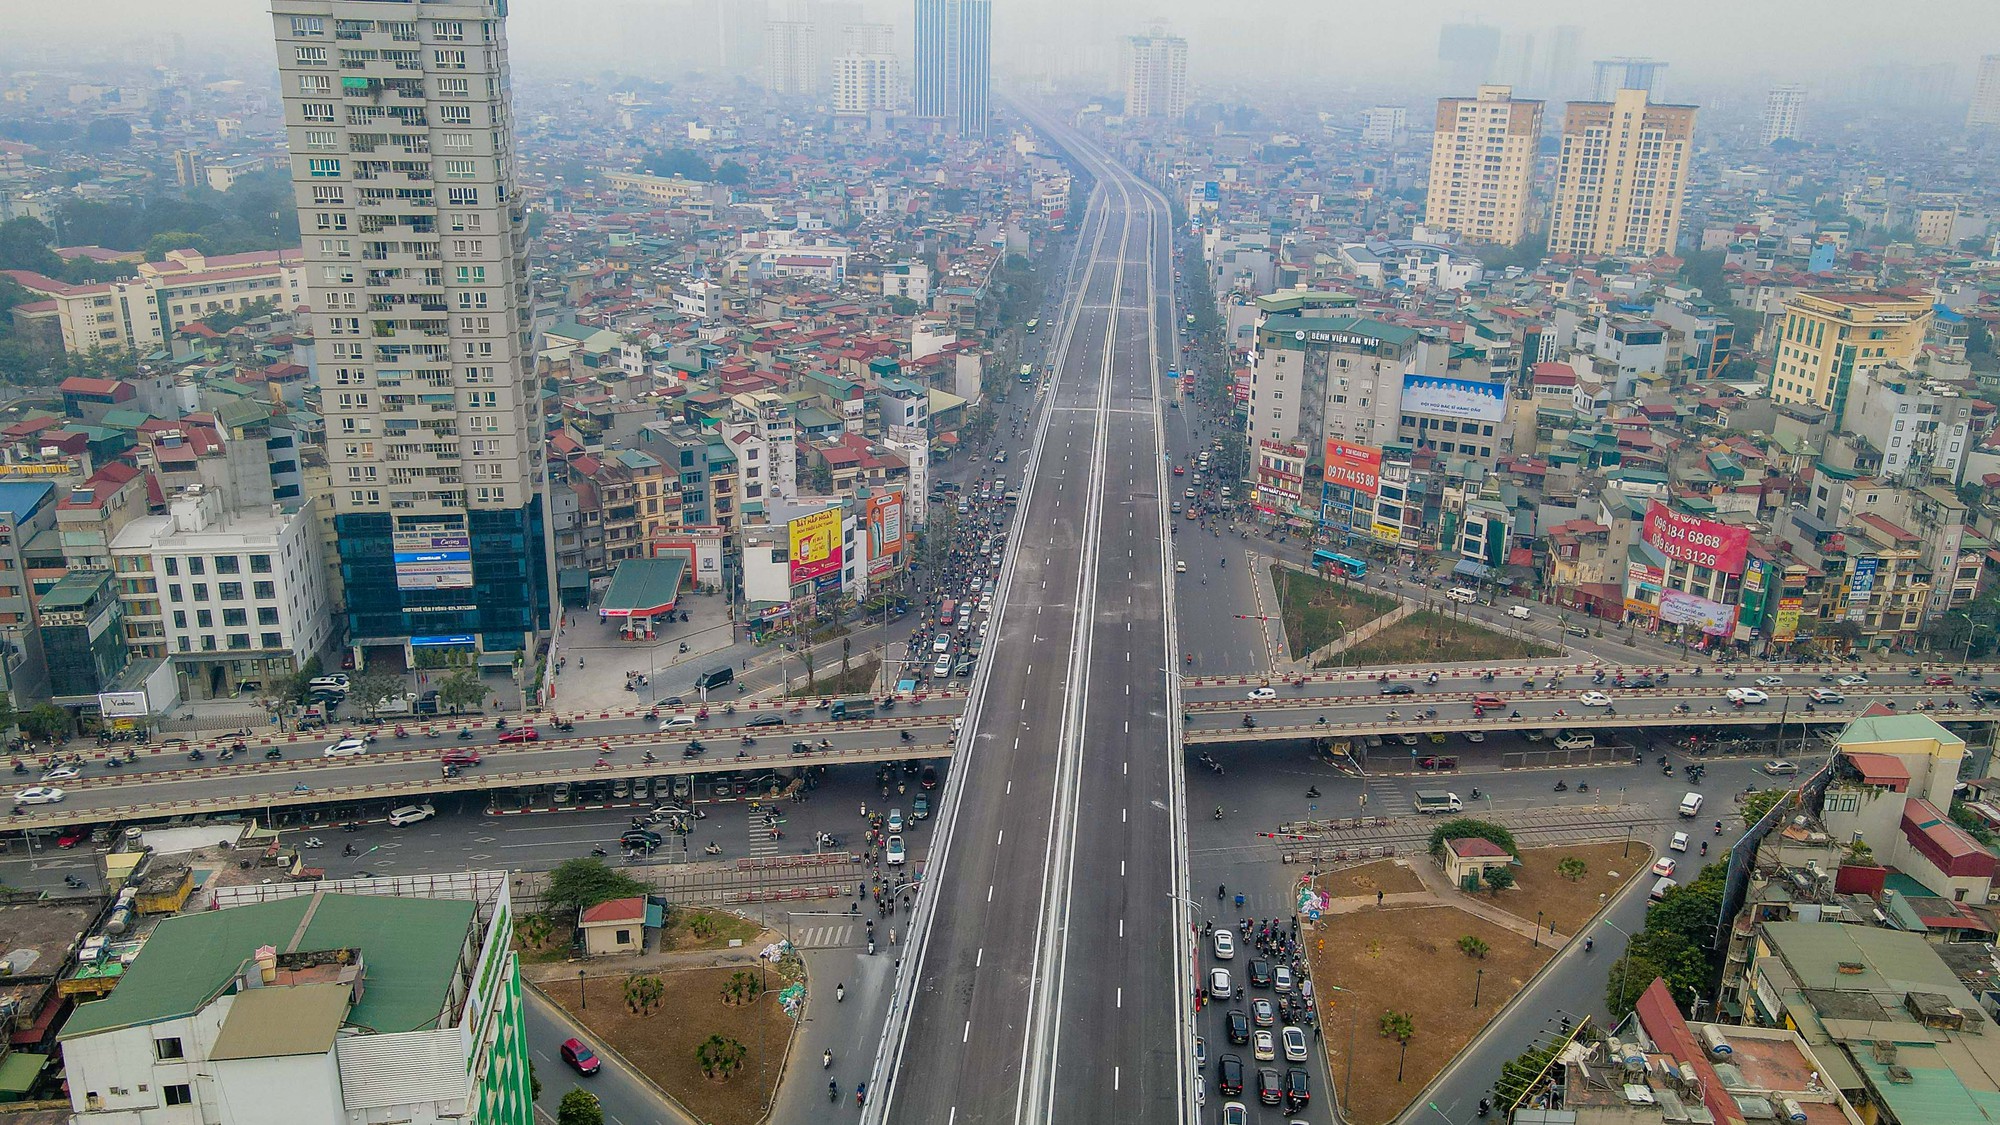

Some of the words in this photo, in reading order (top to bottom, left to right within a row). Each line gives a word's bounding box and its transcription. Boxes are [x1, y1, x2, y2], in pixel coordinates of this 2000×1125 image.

[1311, 331, 1330, 341] BỆNH
[1331, 333, 1348, 344] VIỆN
[1350, 336, 1361, 345] AN
[1363, 336, 1380, 347] VIỆT
[1654, 515, 1667, 532] 096
[1667, 523, 1685, 540] 184
[1687, 530, 1720, 549] 6868
[1652, 533, 1664, 550] 039
[1664, 541, 1681, 558] 641
[1684, 548, 1716, 566] 3126
